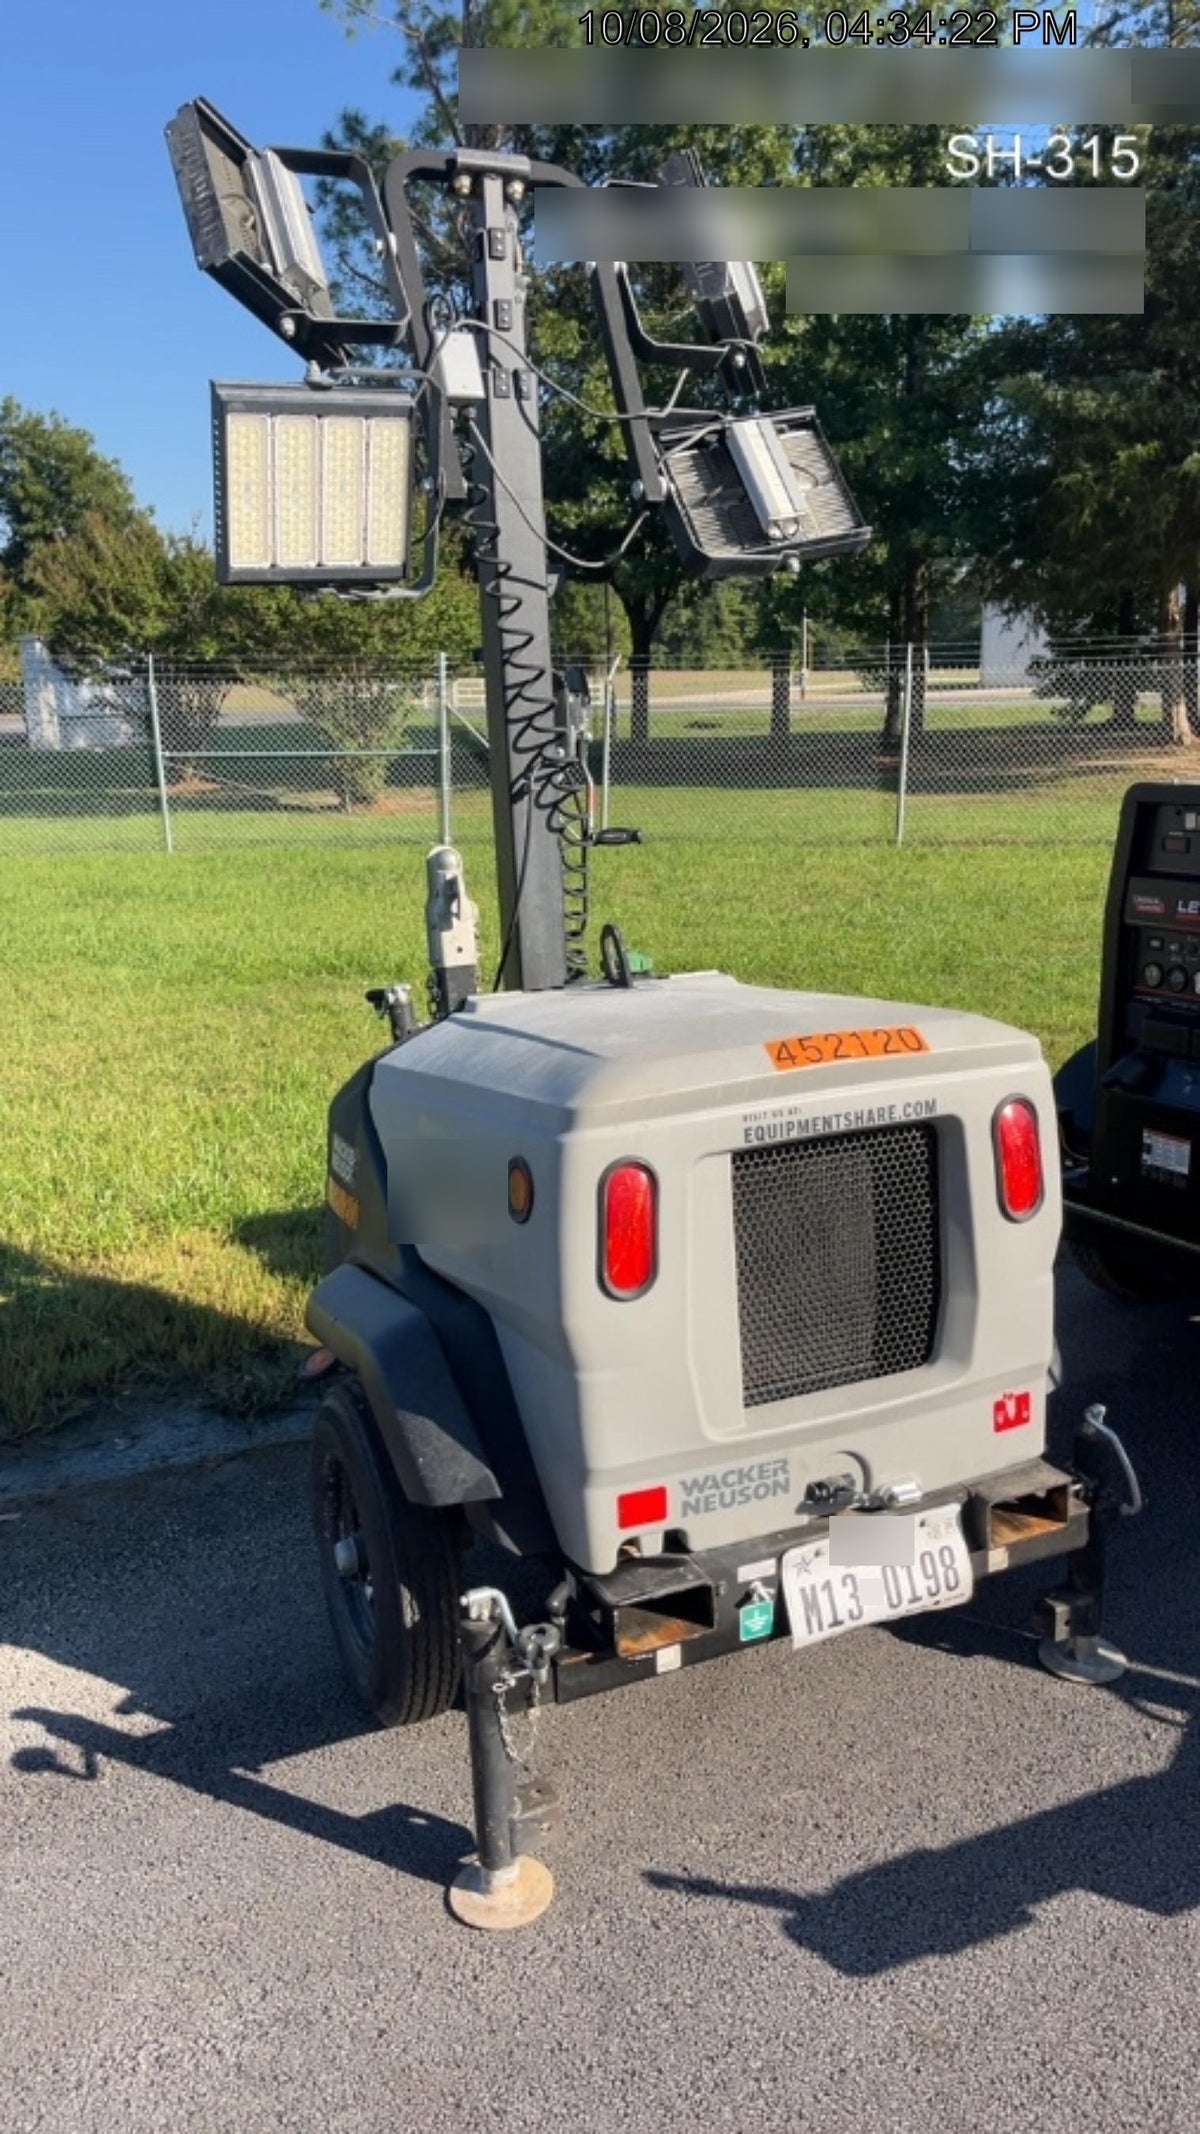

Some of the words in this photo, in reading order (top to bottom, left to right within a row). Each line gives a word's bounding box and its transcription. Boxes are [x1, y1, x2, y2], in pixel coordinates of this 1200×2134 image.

[774, 1027, 925, 1066] 452120
[743, 1098, 938, 1144] EQUIPMENTSHARE.COM
[679, 1458, 790, 1497] WACKER
[681, 1476, 791, 1519] NEUSON
[800, 1573, 863, 1635] M13
[881, 1545, 959, 1609] 0198
